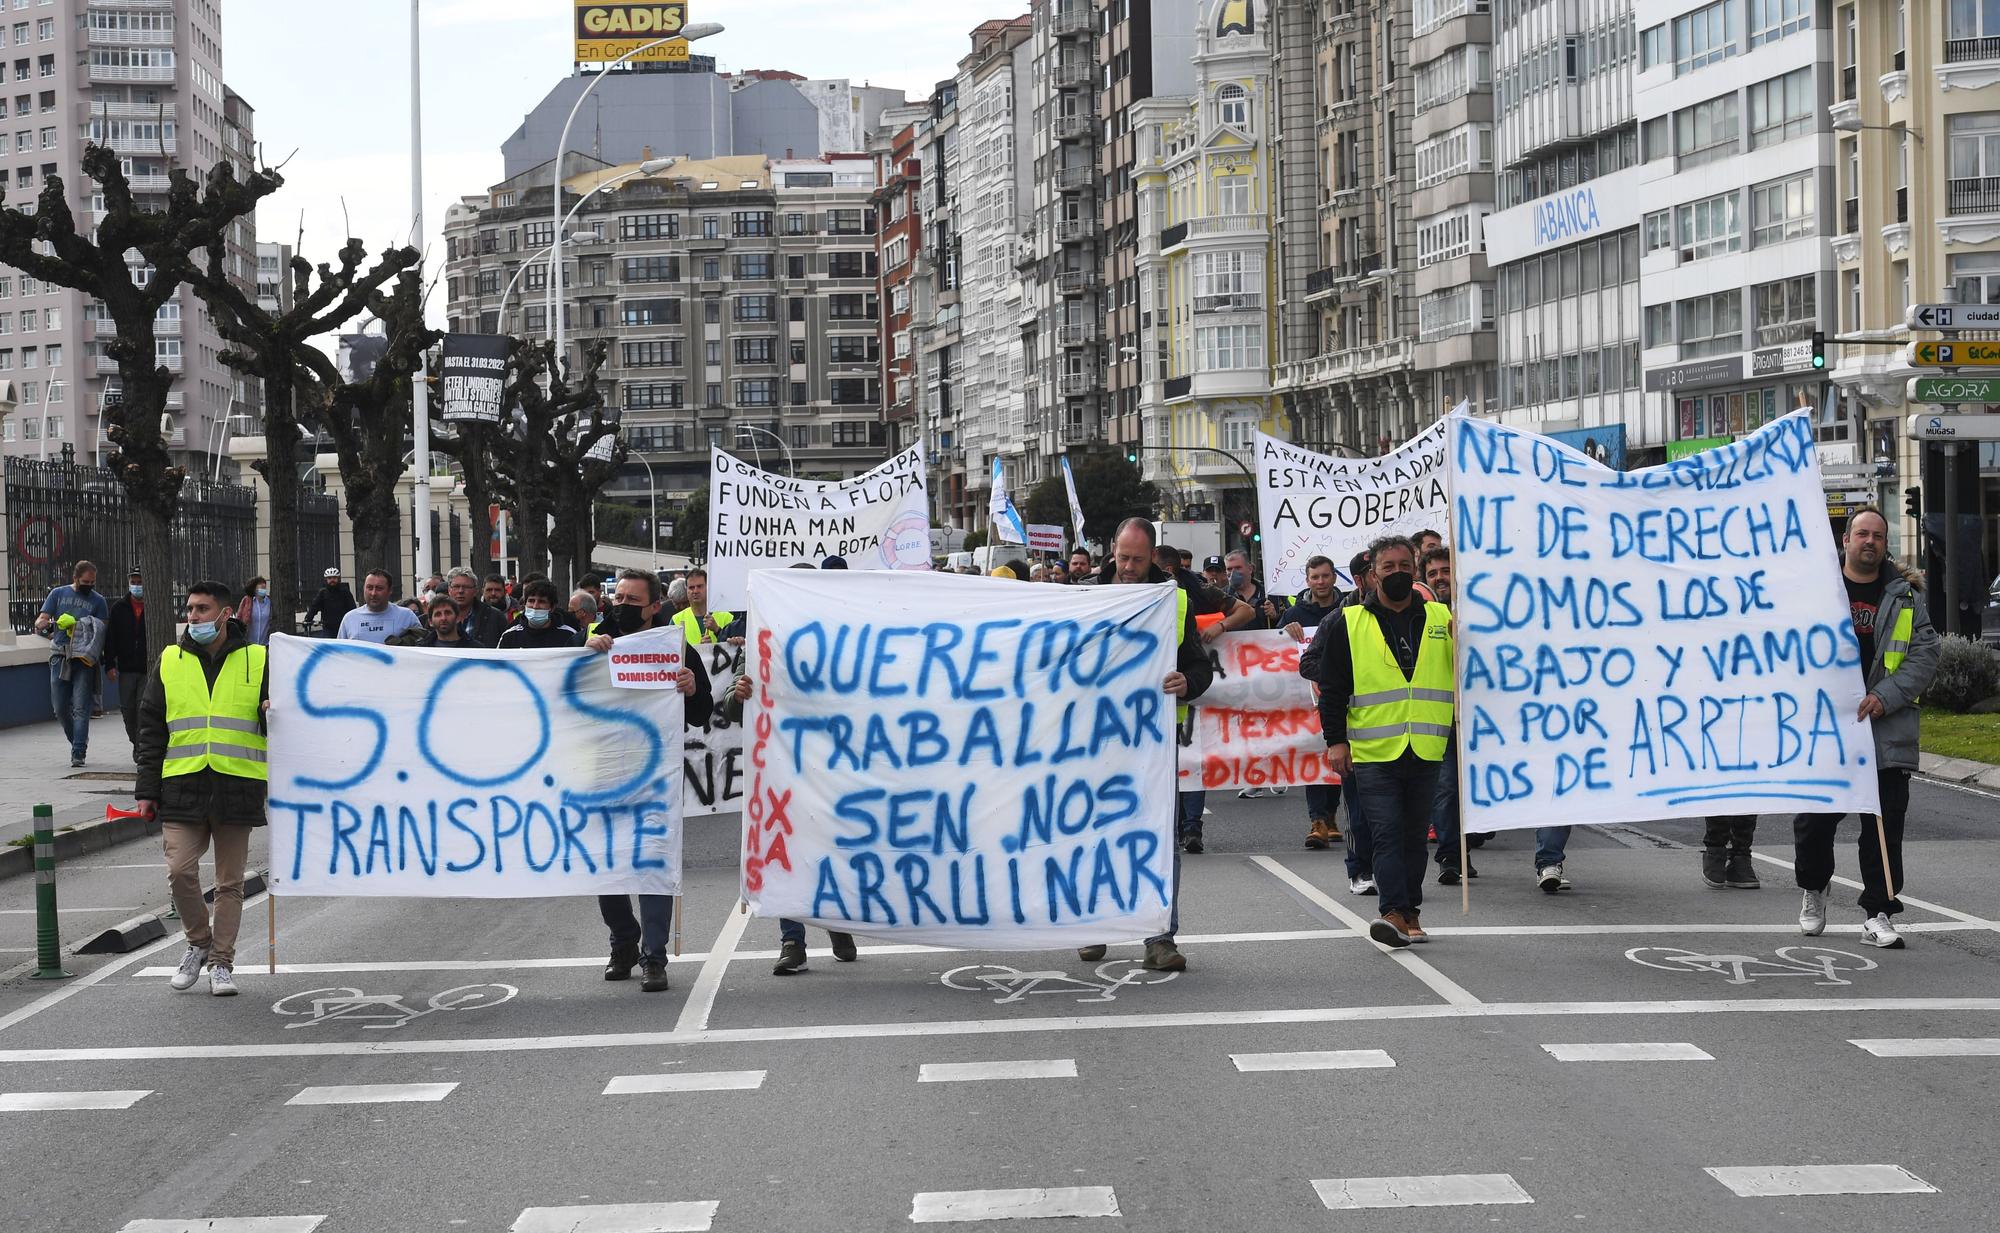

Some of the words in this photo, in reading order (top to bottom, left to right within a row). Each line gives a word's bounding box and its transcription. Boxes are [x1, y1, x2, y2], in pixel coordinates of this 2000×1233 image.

[583, 7, 681, 32] GADIS
[577, 43, 598, 58] En
[604, 42, 686, 58] Confianza
[1535, 187, 1600, 246] ABANCA
[1966, 311, 2000, 321] ciudad
[463, 356, 471, 367] EL
[471, 357, 505, 370] 31.03.2022
[1753, 353, 1783, 371] BRIGANTIA
[1939, 347, 1952, 361] P
[1968, 346, 1980, 359] El
[444, 388, 469, 401] UNTOLD
[470, 389, 502, 403] STORIES
[445, 376, 463, 388] PETER
[464, 376, 503, 391] LINDBERGH
[1925, 380, 1990, 397] ÁGORA
[474, 401, 500, 415] GALICIA
[1457, 419, 1521, 475] NI
[1532, 439, 1588, 487] DE
[716, 454, 729, 473] O
[735, 462, 804, 492] GASOIL
[1269, 468, 1327, 490] ESTA
[1333, 479, 1362, 492] EN
[719, 481, 810, 510] FUNDEN
[820, 496, 836, 510] A
[849, 471, 924, 507] FLOTA
[1847, 507, 1854, 515] P
[717, 513, 729, 535] E
[739, 515, 797, 536] UNHA
[809, 516, 855, 536] MAN
[1028, 531, 1062, 540] GOBIERNO
[1457, 495, 1516, 558] NI
[1537, 503, 1590, 560] DE
[1609, 498, 1807, 563] DERECHA
[813, 541, 828, 558] A
[838, 535, 879, 557] BOTA
[895, 541, 921, 551] LORBE
[1271, 534, 1310, 584] GASOIL
[1466, 571, 1645, 634] SOMOS
[1657, 577, 1728, 622] LOS
[1734, 570, 1773, 615] DE
[611, 653, 680, 665] GOBIERNO
[783, 618, 1160, 700] QUEREMOS
[1464, 643, 1635, 695] ABAJO
[1656, 645, 1683, 688] Y
[1702, 621, 1862, 683] VAMOS
[617, 669, 677, 682] DIMISIÓN
[779, 688, 1164, 774] TRABALLAR
[1469, 705, 1506, 752] A
[1519, 697, 1608, 744] POR
[1468, 761, 1534, 808] LOS
[1555, 747, 1612, 796] DE
[833, 783, 977, 855] SEN
[268, 795, 669, 881] TRANSPORTE
[811, 830, 1170, 926] ARRUINAR
